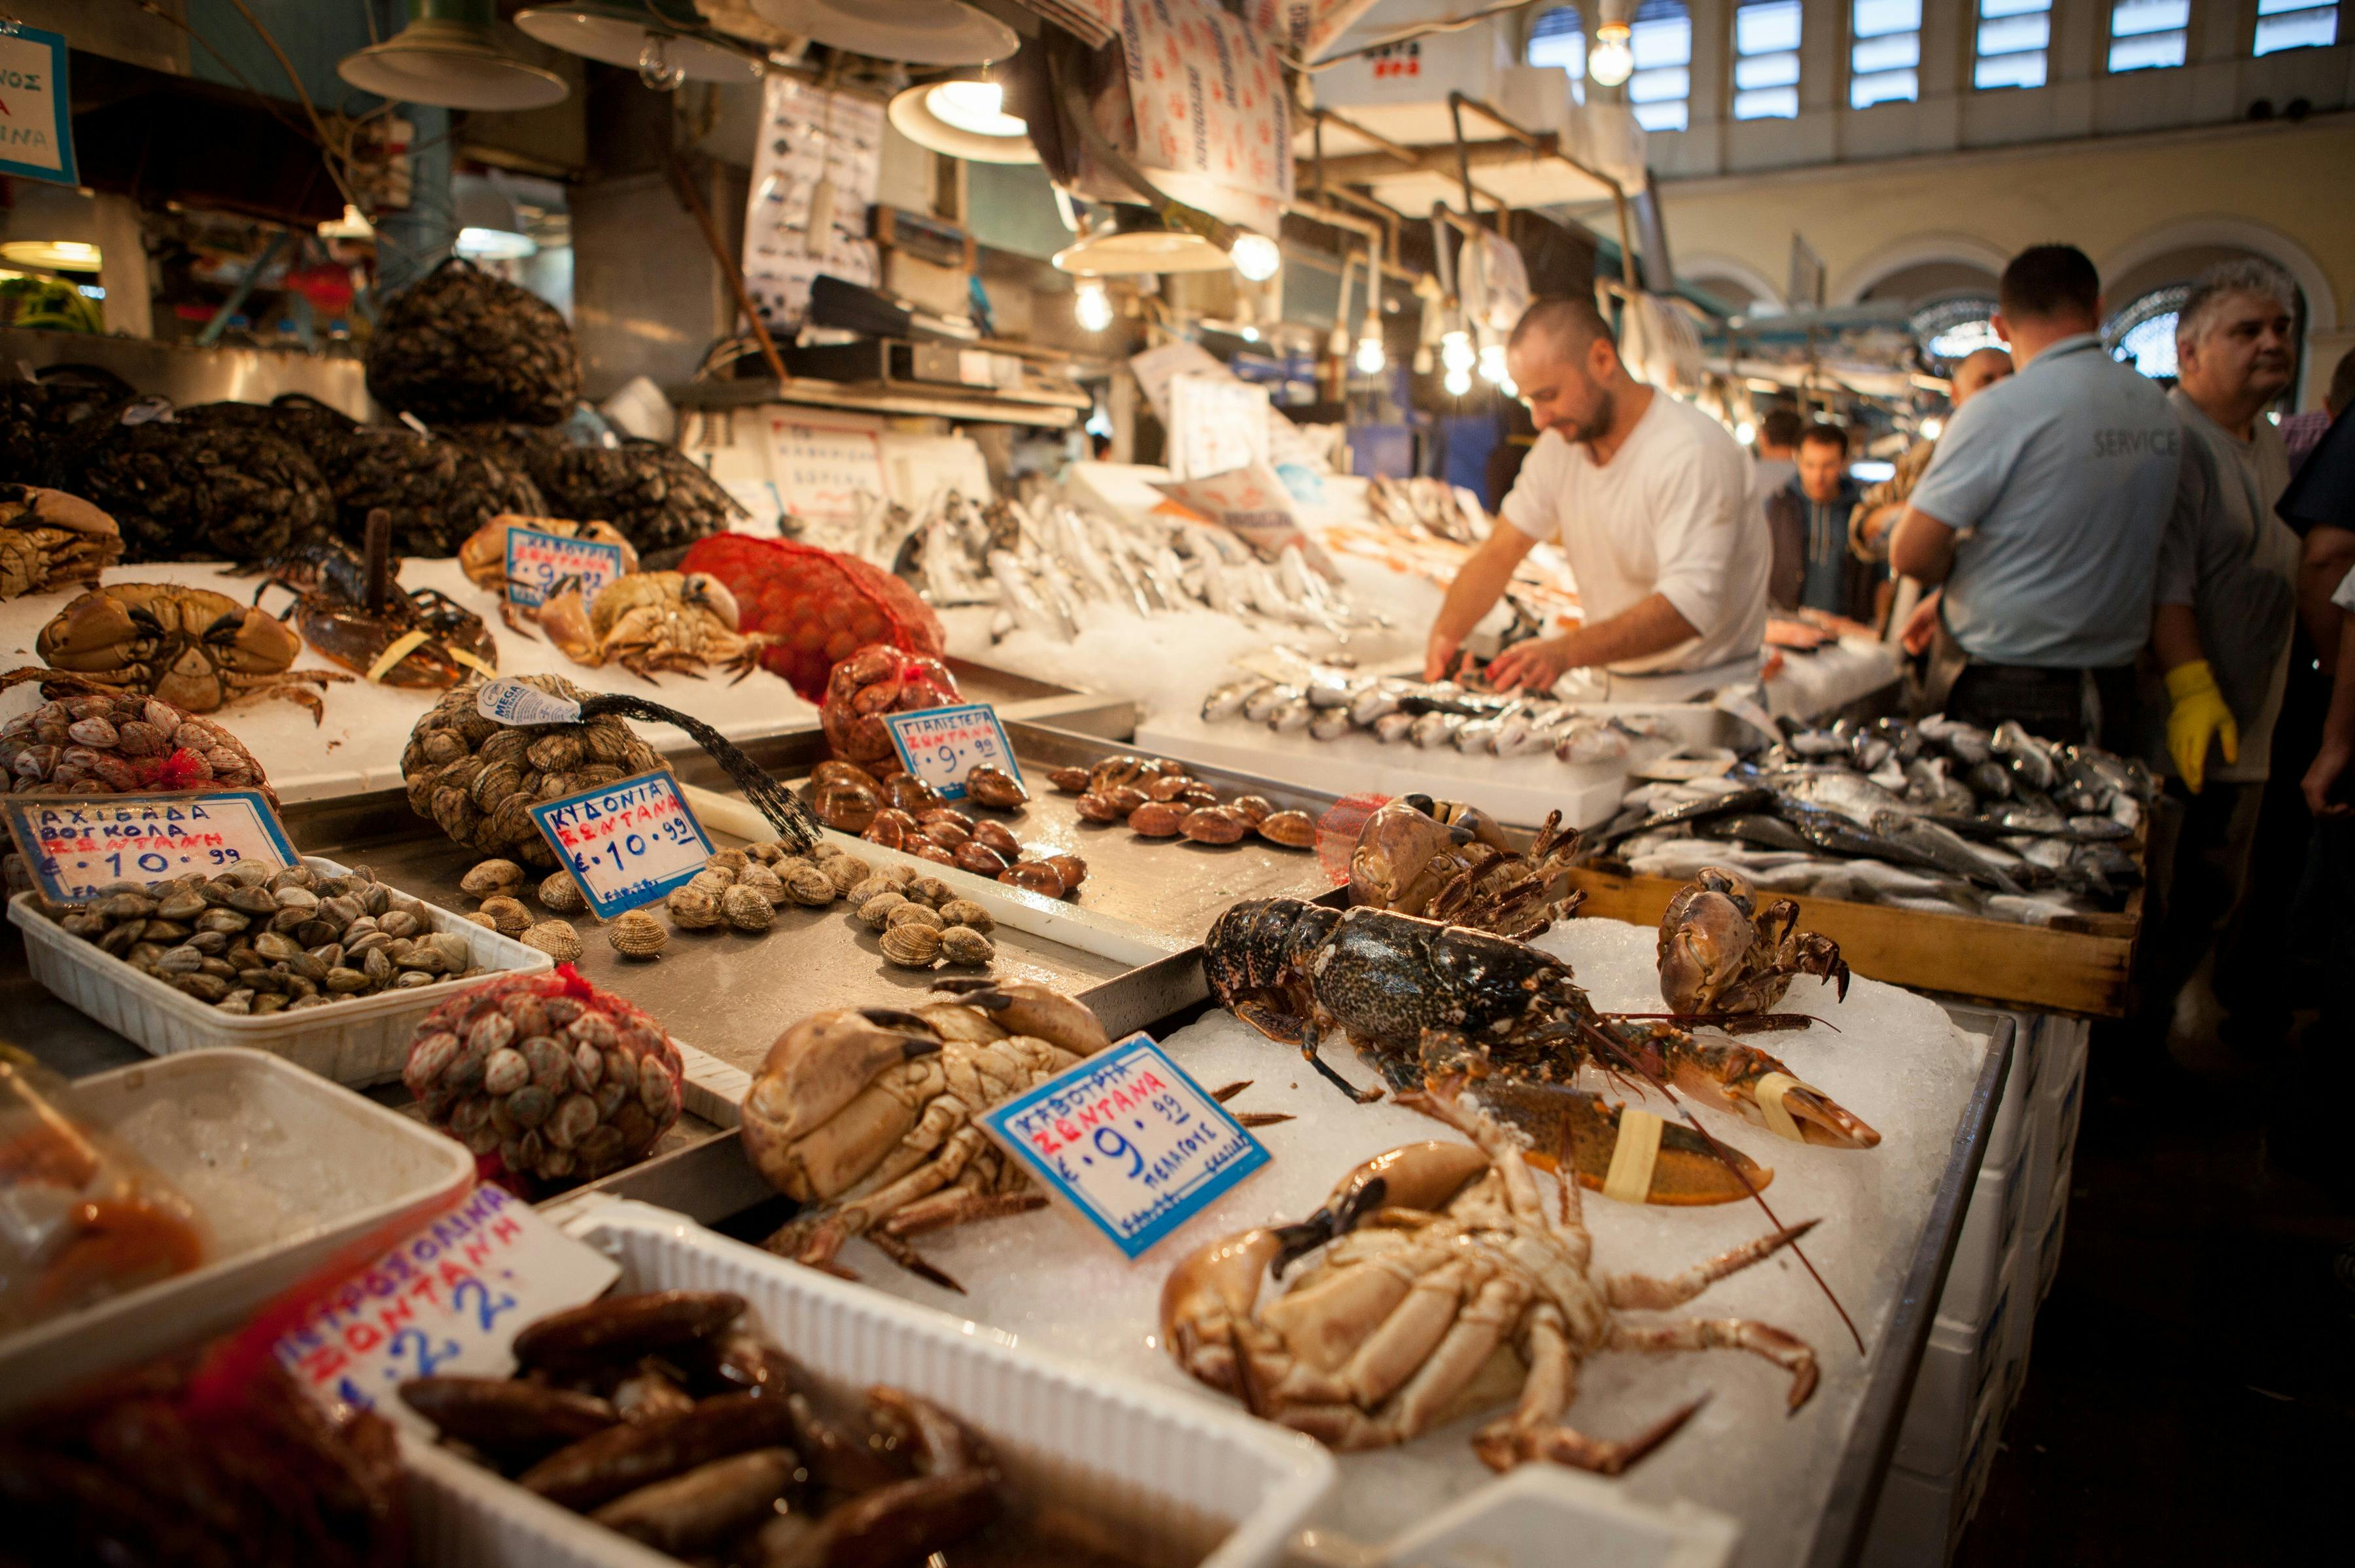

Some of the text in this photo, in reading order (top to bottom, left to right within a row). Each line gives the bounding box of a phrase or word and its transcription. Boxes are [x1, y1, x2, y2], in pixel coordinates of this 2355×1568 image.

[2093, 428, 2179, 457] SERVICE
[495, 686, 521, 717] MEGA
[550, 780, 663, 830] ΚΥΔΟΝΙΑ
